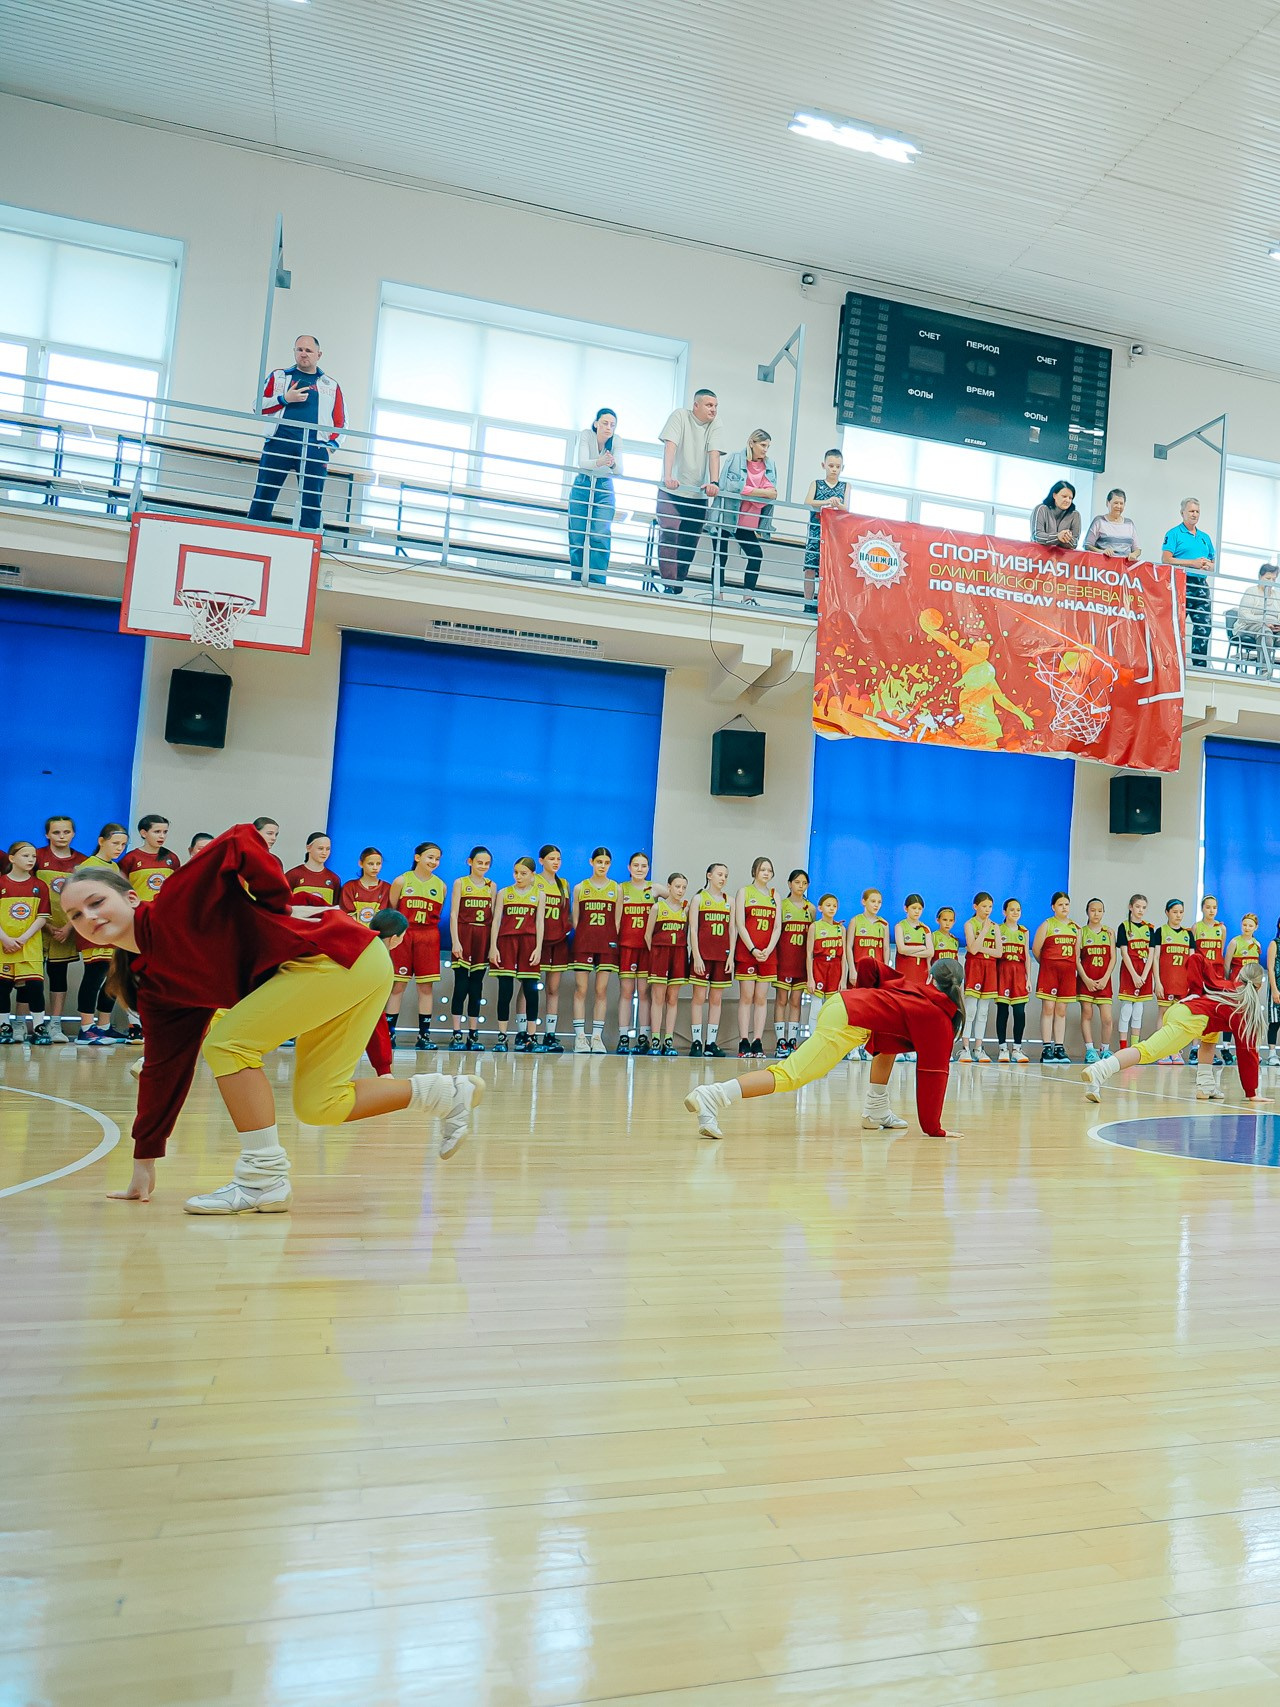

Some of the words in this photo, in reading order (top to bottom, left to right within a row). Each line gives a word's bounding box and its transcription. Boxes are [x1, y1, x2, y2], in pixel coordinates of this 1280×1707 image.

[918, 329, 941, 341] СЧЕТ
[966, 340, 1000, 354] ПЕРИОД
[1036, 355, 1057, 366] СЧЕТ
[907, 388, 934, 399] ФОЛЫ
[966, 385, 995, 398] ВРЕМЯ
[1023, 411, 1048, 422] ФОЛЫ
[859, 551, 898, 567] НАДЕЖДА
[929, 542, 1070, 578] СПОРТИВНАЯ
[1074, 565, 1143, 592] ШКОЛА
[929, 563, 1054, 593] ОЛИМПИЙСКОГО
[1057, 583, 1120, 603] РЕЗЕРВА
[929, 579, 953, 592] ПО
[955, 582, 1053, 607] БАСКЕТБОЛУ
[1056, 599, 1145, 621] «НАДЕЖДА»
[545, 906, 560, 920] 70
[584, 902, 606, 911] СШОР
[475, 910, 485, 922] 3
[589, 912, 606, 926] 25
[631, 916, 644, 928] 75
[515, 917, 525, 930] 7
[711, 923, 724, 936] 10
[756, 918, 769, 931] 79
[670, 932, 677, 945] 1
[790, 933, 804, 946] 40
[1061, 946, 1073, 957] 29
[1092, 956, 1104, 967] 43
[1172, 955, 1184, 966] 27
